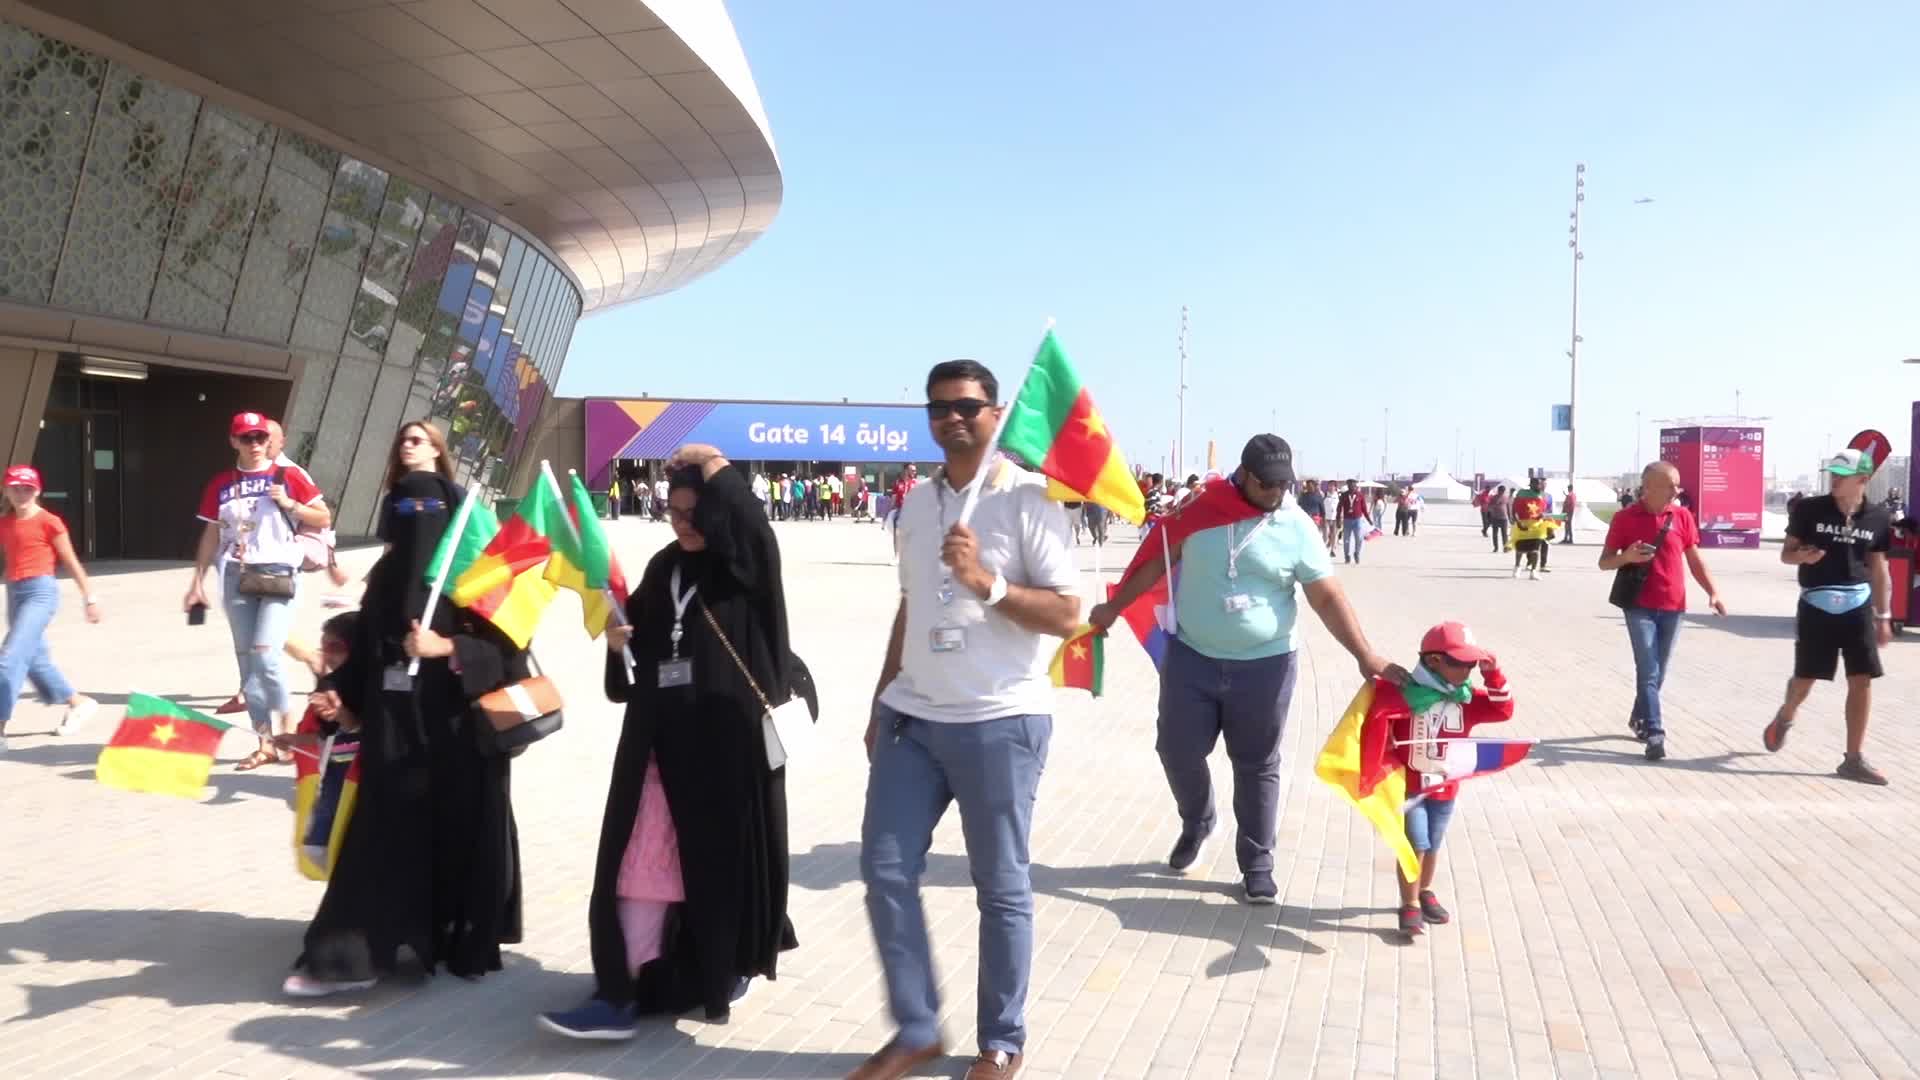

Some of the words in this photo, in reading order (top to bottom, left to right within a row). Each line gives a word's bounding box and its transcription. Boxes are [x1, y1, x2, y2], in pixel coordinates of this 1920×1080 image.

[748, 421, 808, 444] Gate
[819, 423, 846, 445] 14
[856, 423, 909, 451] بوابة
